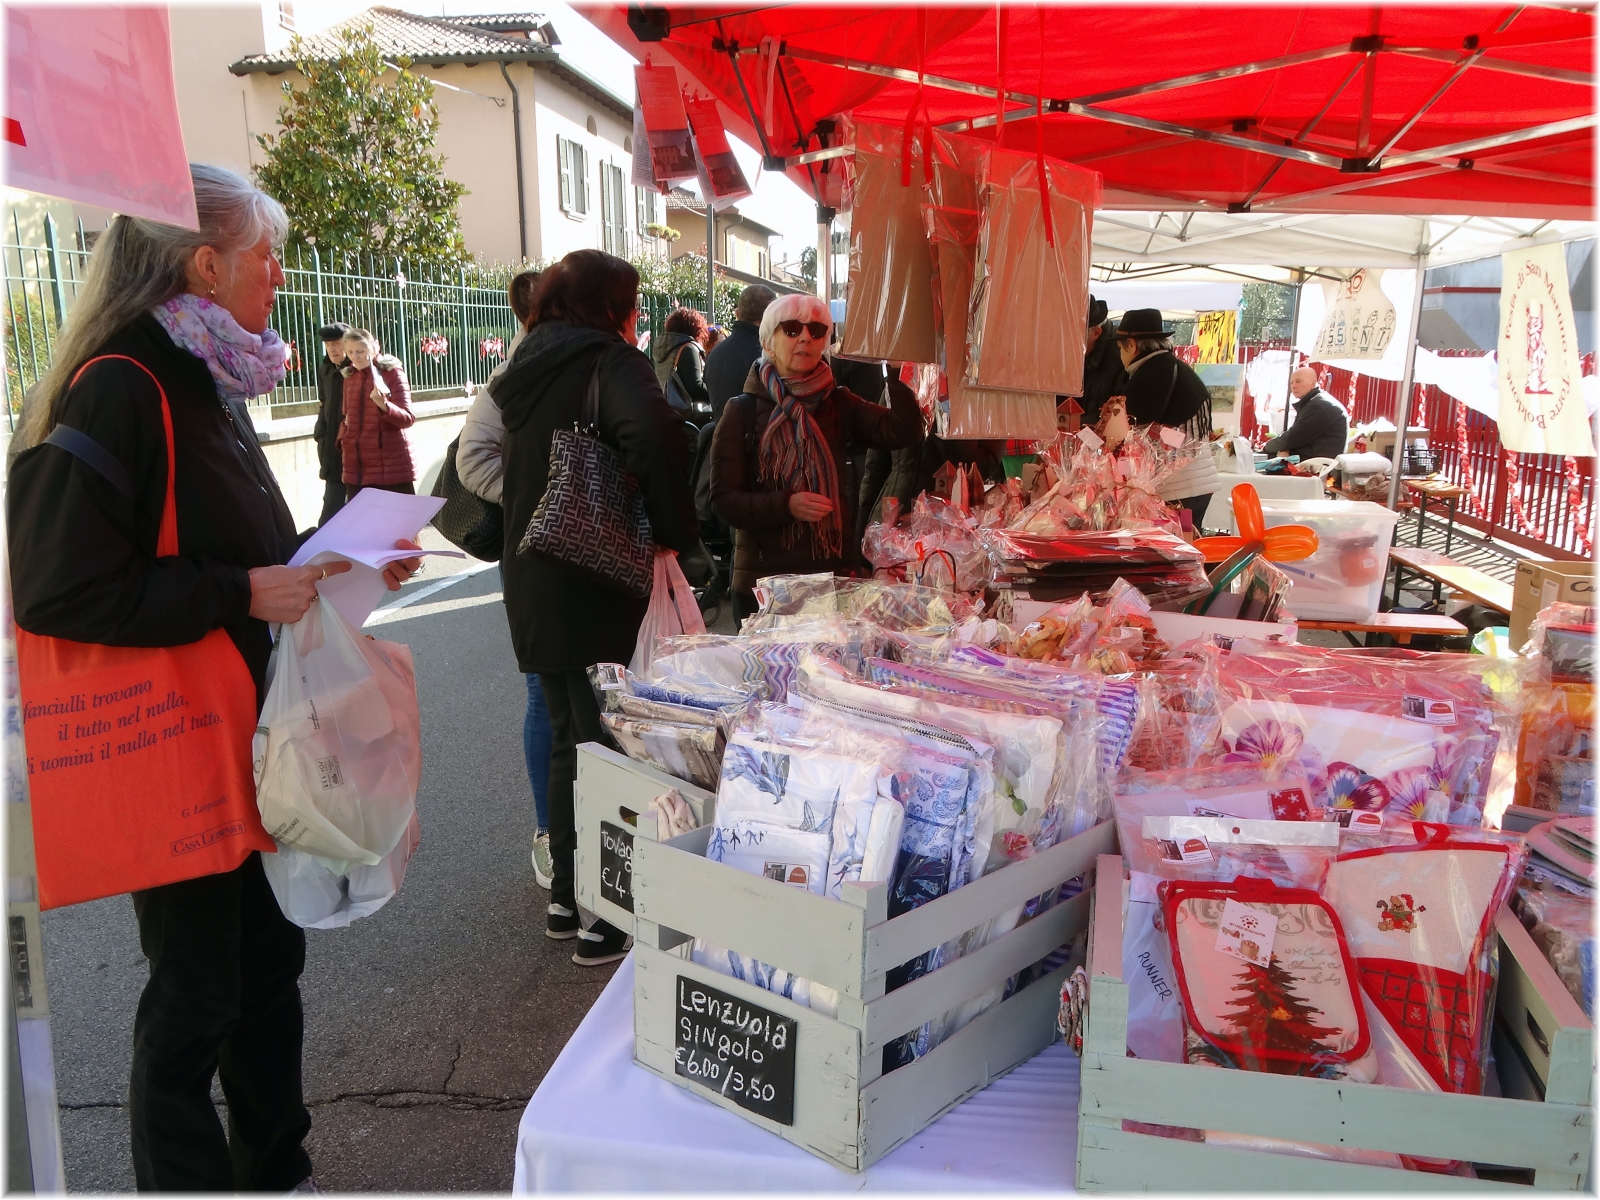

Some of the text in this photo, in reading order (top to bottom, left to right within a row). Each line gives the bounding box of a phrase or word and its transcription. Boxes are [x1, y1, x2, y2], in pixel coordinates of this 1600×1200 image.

[1525, 259, 1543, 279] San
[23, 679, 153, 724] fanciulli trovano
[57, 690, 190, 742] il tutto nel nulla,
[40, 750, 95, 773] uomini
[100, 741, 112, 761] il
[115, 730, 158, 757] nulla
[162, 716, 186, 740] nel
[190, 711, 224, 731] tutto.
[1137, 951, 1173, 1003] RUNNER
[679, 979, 788, 1050] Lenzuola
